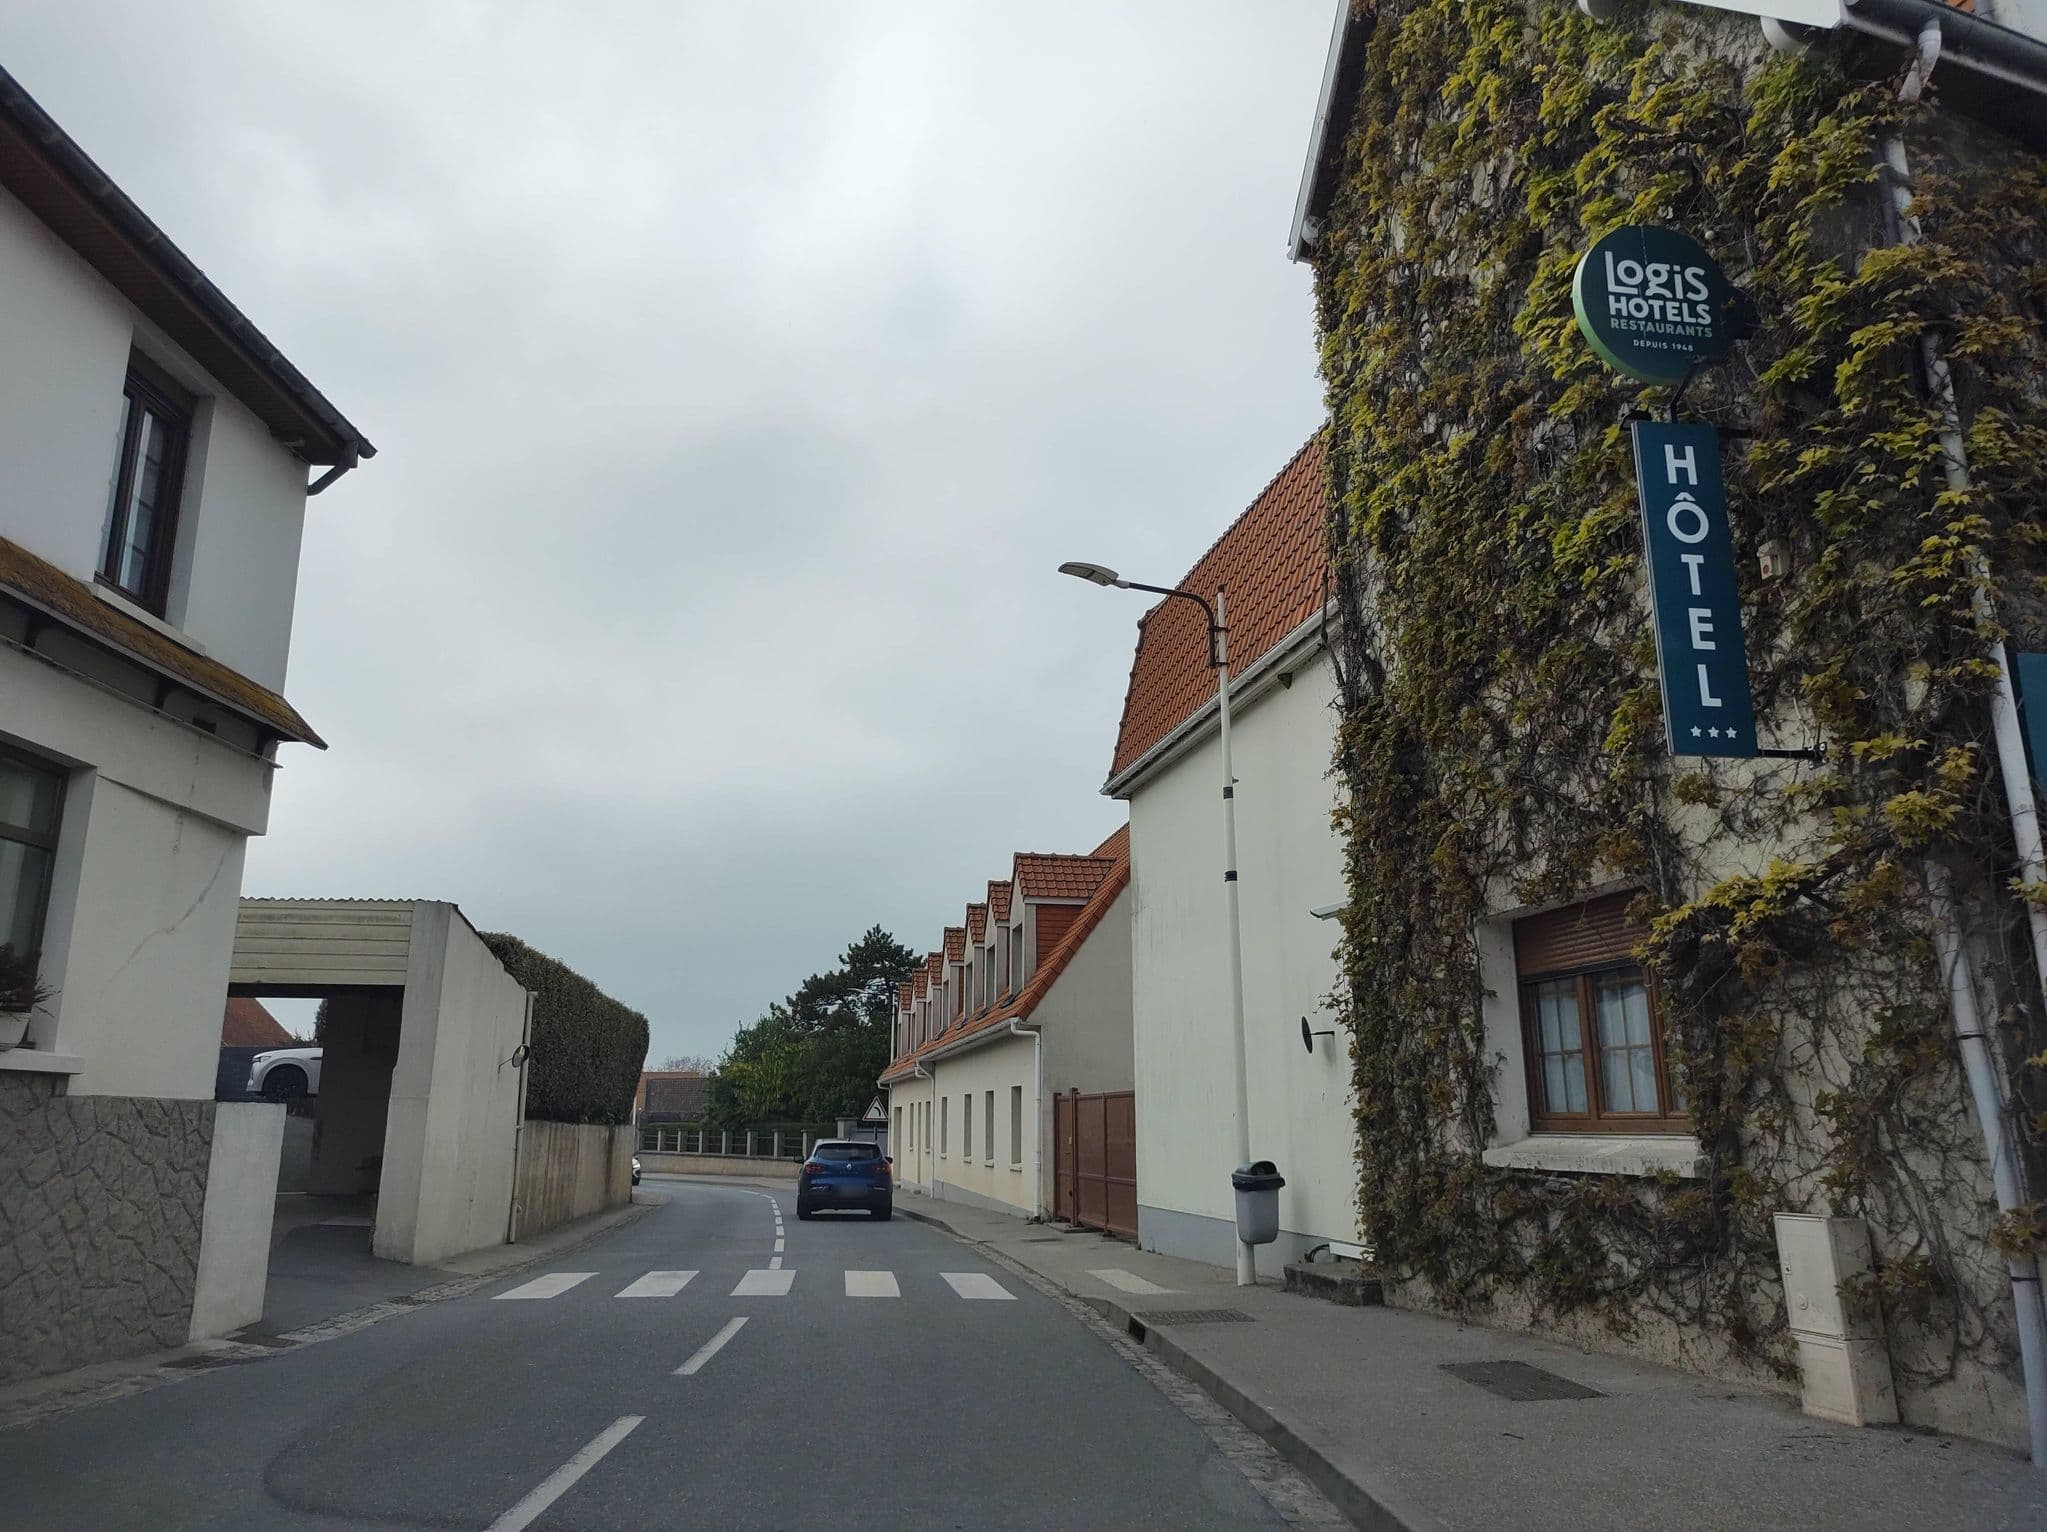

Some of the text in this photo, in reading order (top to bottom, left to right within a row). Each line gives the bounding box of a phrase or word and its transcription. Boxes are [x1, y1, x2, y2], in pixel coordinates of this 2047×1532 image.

[1608, 295, 1712, 325] HOTELS
[1611, 318, 1712, 337] RESTAURANTS
[1633, 339, 1668, 349] DEPUIS
[1664, 444, 1722, 707] HÔTEL
